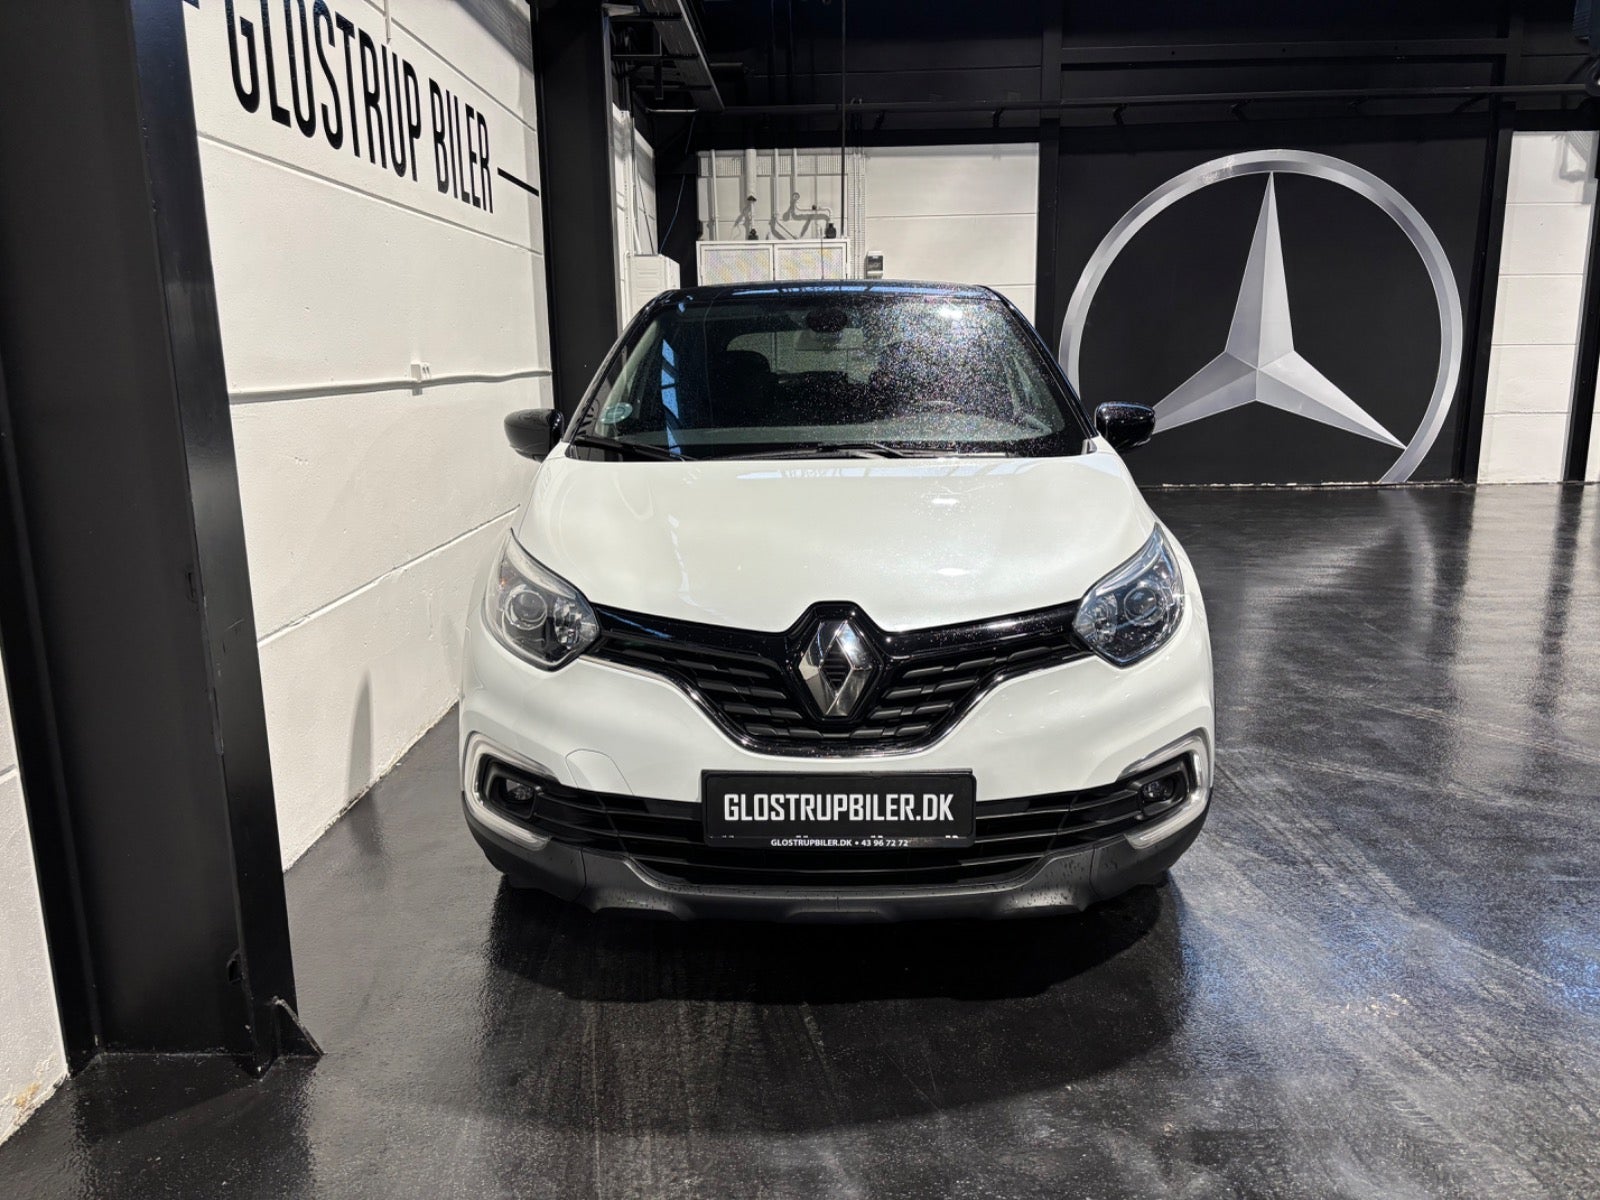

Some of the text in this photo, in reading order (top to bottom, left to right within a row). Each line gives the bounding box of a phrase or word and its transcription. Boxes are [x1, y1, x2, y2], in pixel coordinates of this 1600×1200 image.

[225, 0, 493, 214] GLOSTRUP BILER
[724, 793, 954, 821] GLOSTRUPBILER.DK
[770, 839, 909, 847] GLOSTRUPBILER.DK 43 96 72 72
